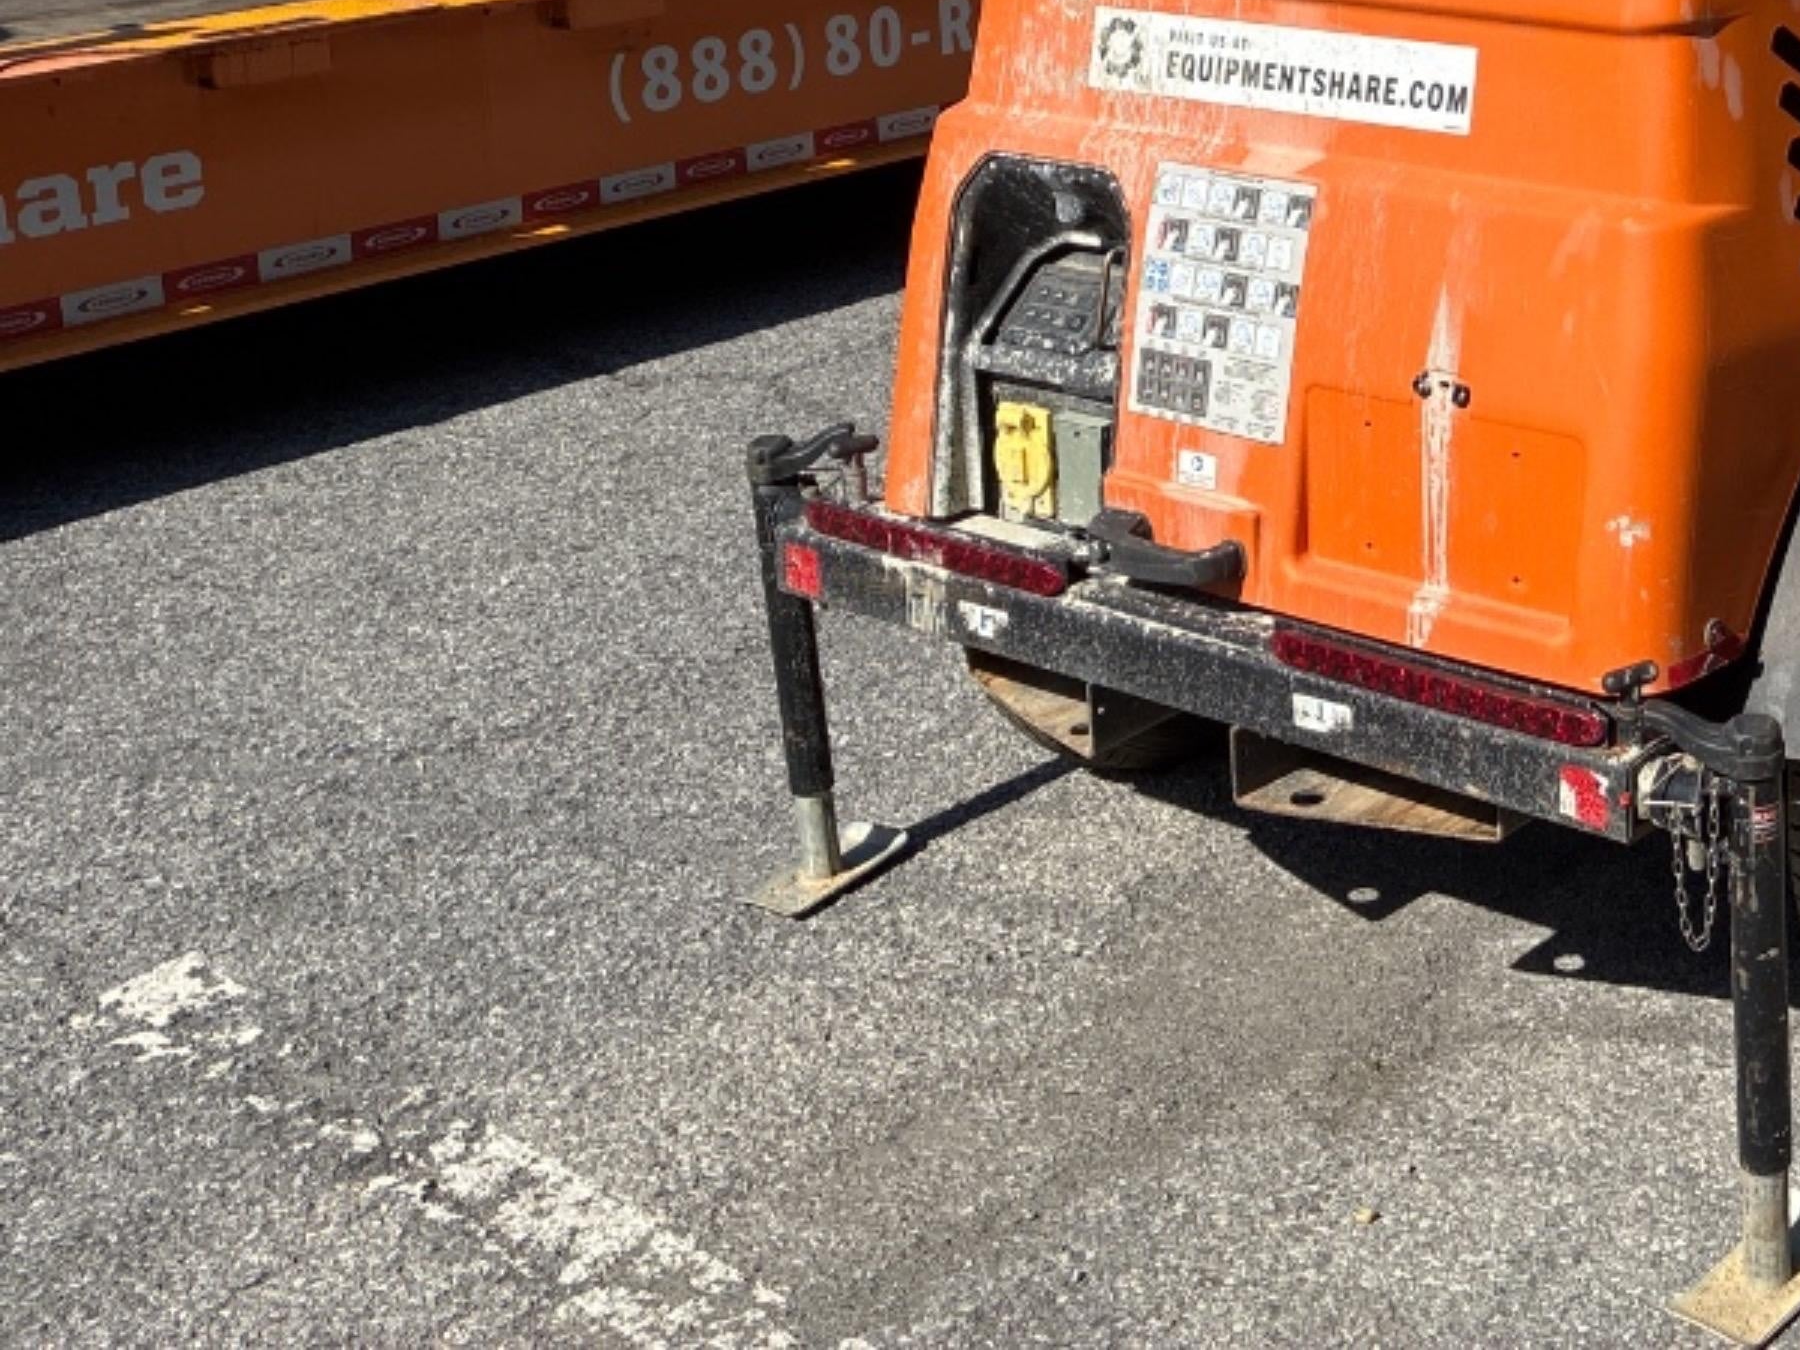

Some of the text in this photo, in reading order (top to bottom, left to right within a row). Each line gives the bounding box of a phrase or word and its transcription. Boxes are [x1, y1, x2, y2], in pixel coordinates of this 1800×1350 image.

[610, 23, 804, 123] (888)
[1166, 50, 1469, 115] EQUIPMENTSHARE.COM
[0, 149, 205, 246] are
